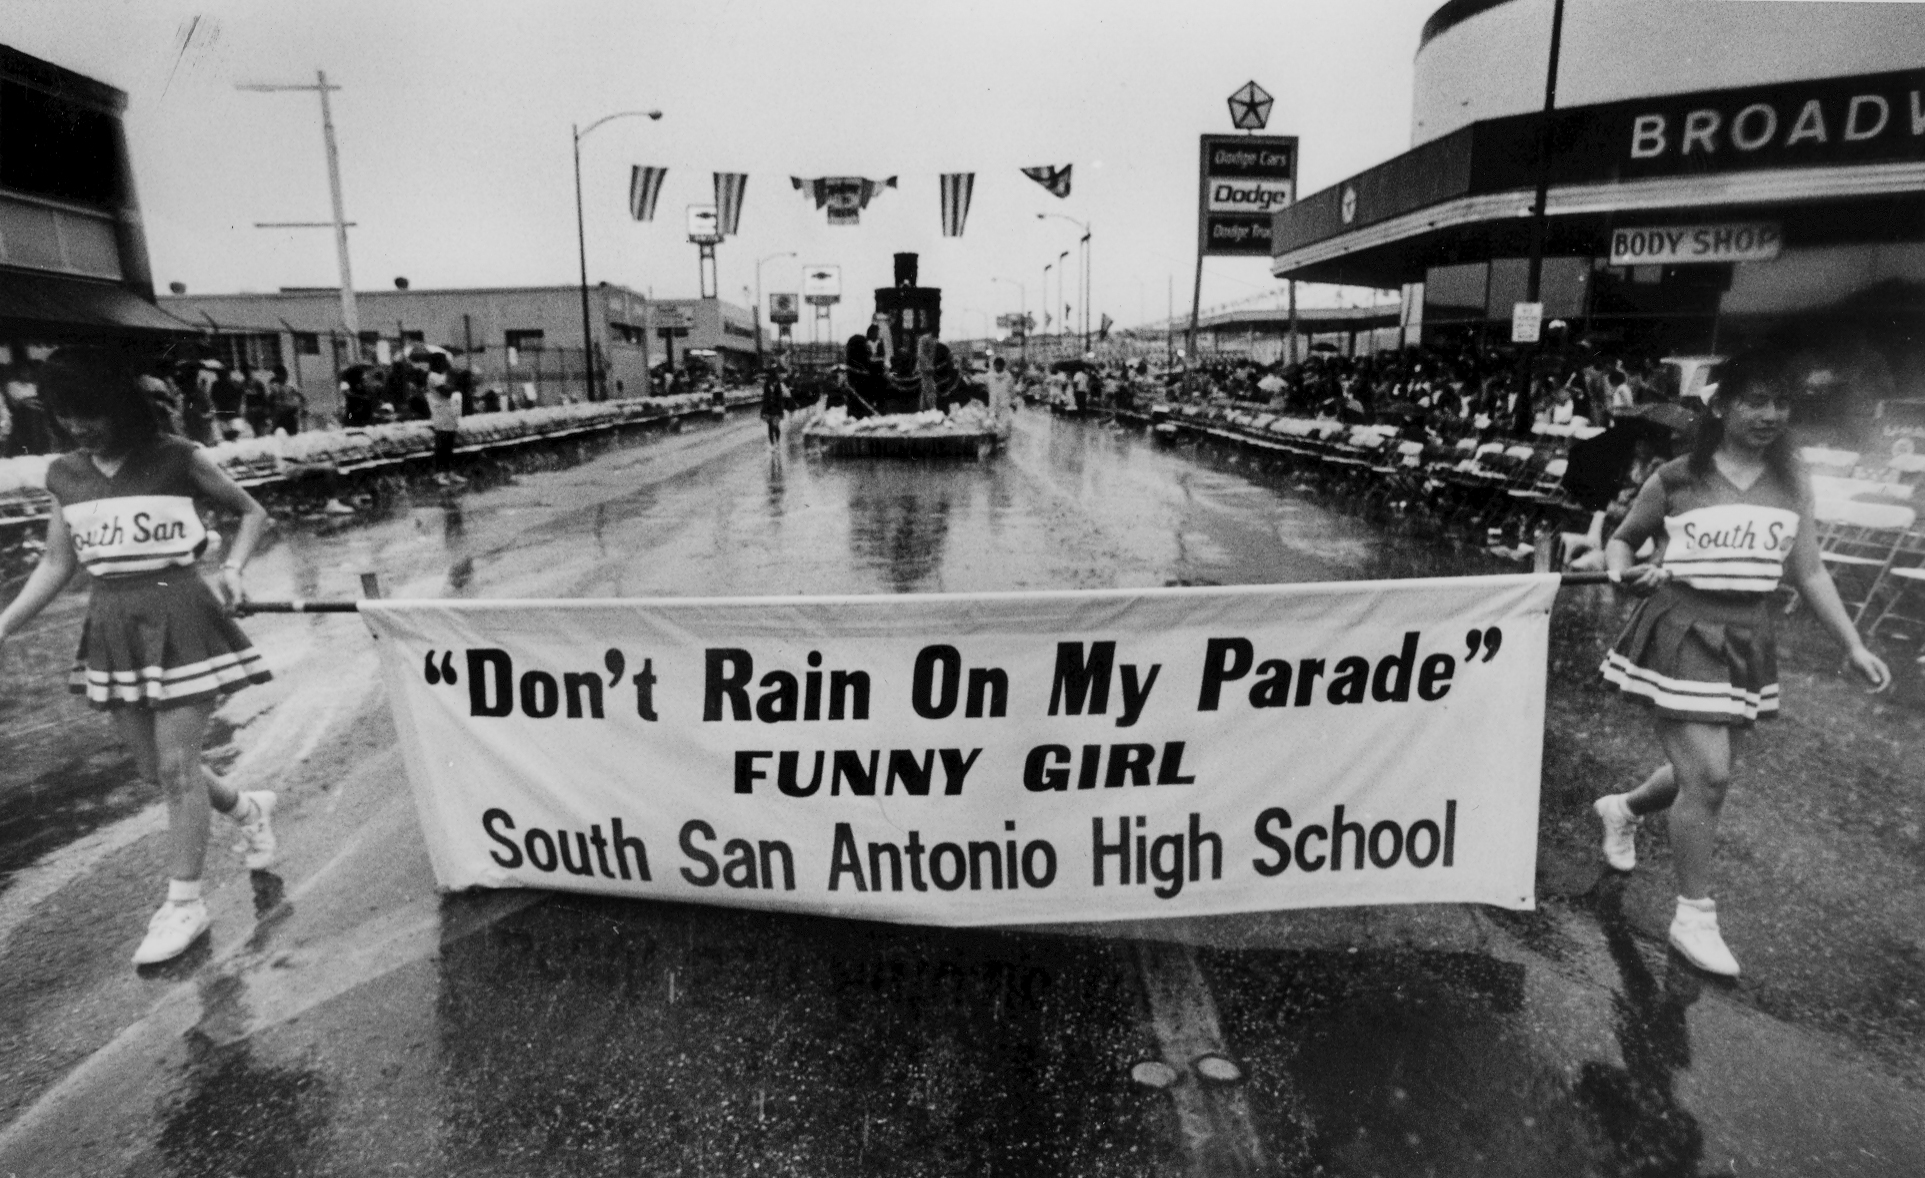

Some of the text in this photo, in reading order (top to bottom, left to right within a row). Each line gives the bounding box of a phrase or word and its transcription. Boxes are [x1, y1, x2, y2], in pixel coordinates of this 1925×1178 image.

[1214, 184, 1286, 209] Dodge
[1614, 226, 1776, 256] BODY SHOP
[68, 512, 186, 551] outh San
[1684, 520, 1756, 550] South
[424, 626, 1503, 728] “Don’t Rain On My Parade”
[734, 740, 1196, 798] FUNNY GIRL
[482, 799, 1457, 900] South San Antonio High School
